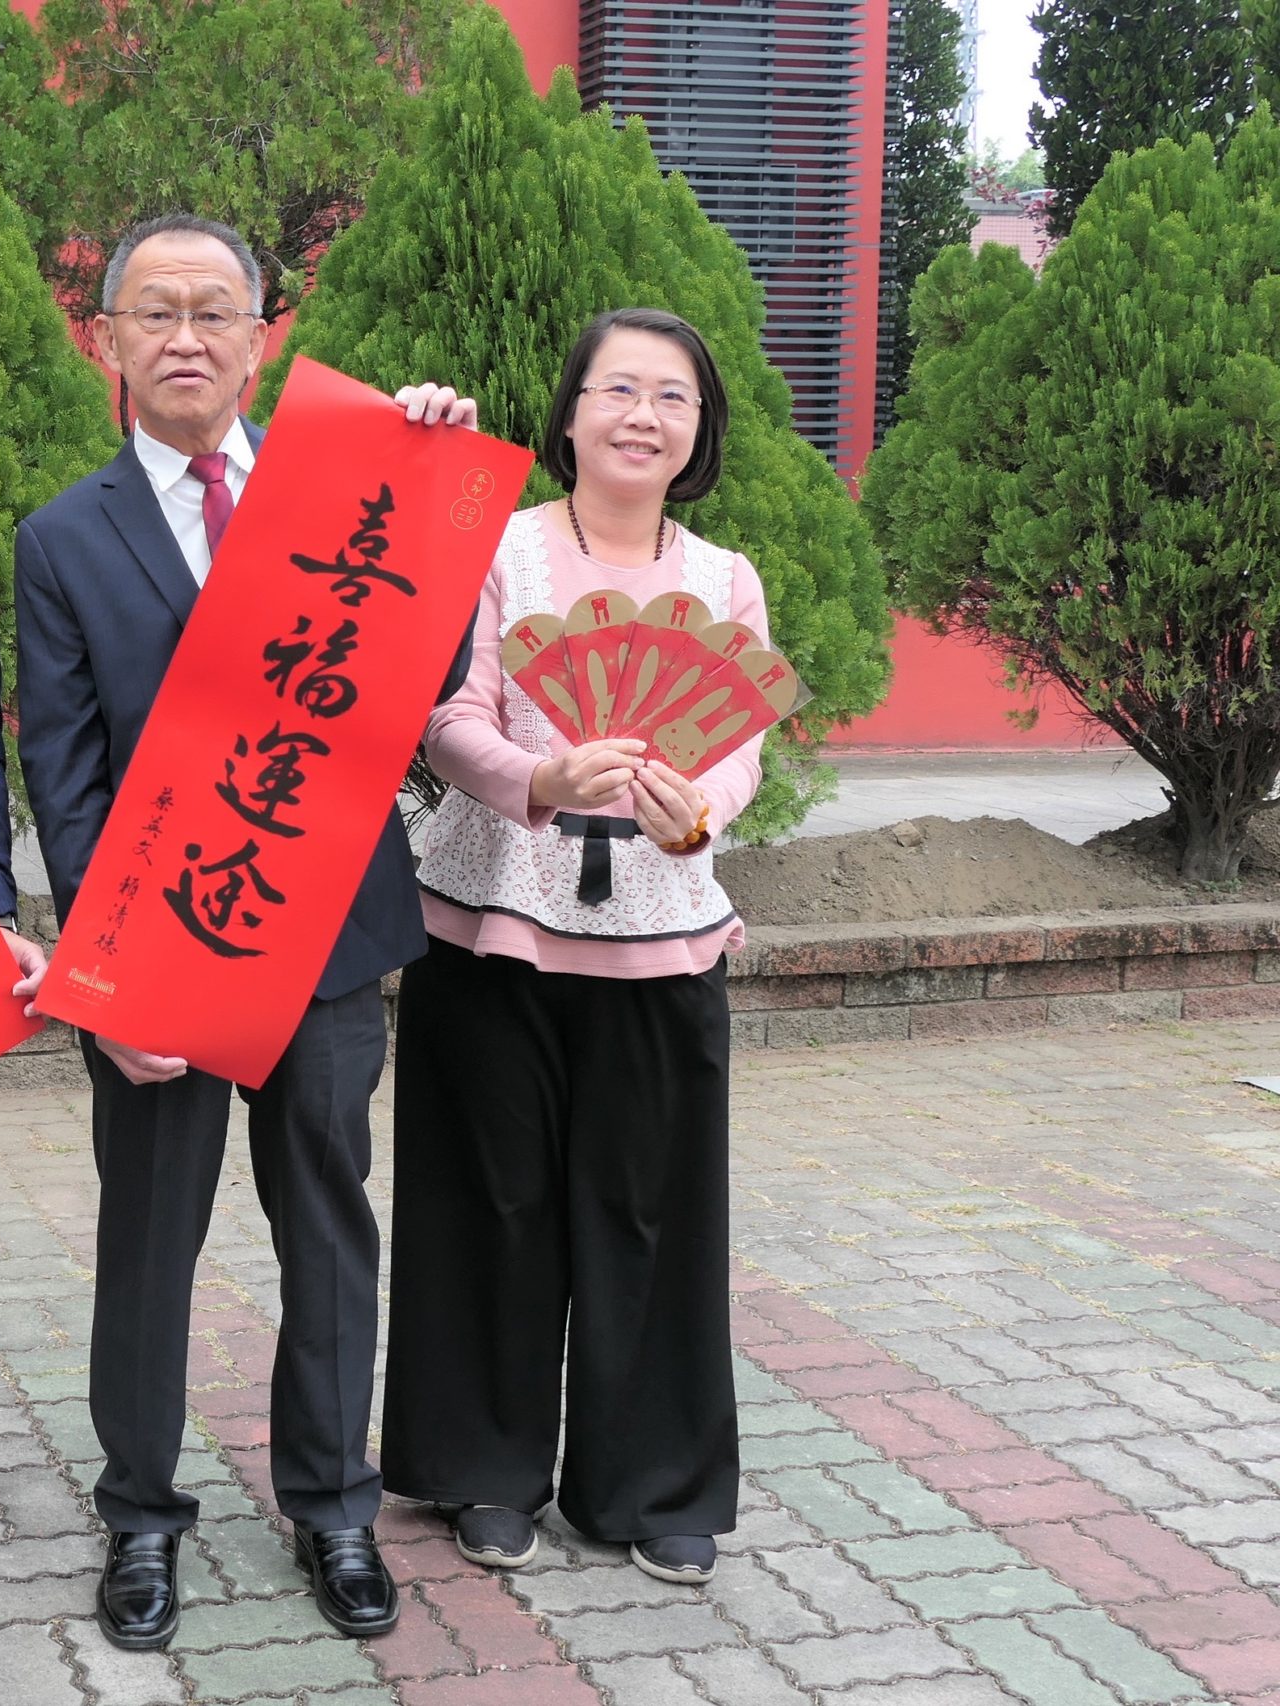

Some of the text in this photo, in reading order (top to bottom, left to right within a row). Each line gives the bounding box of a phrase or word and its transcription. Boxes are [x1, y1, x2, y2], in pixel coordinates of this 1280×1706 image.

[134, 786, 174, 866] 蔡英文
[162, 482, 417, 958] 喜福運途
